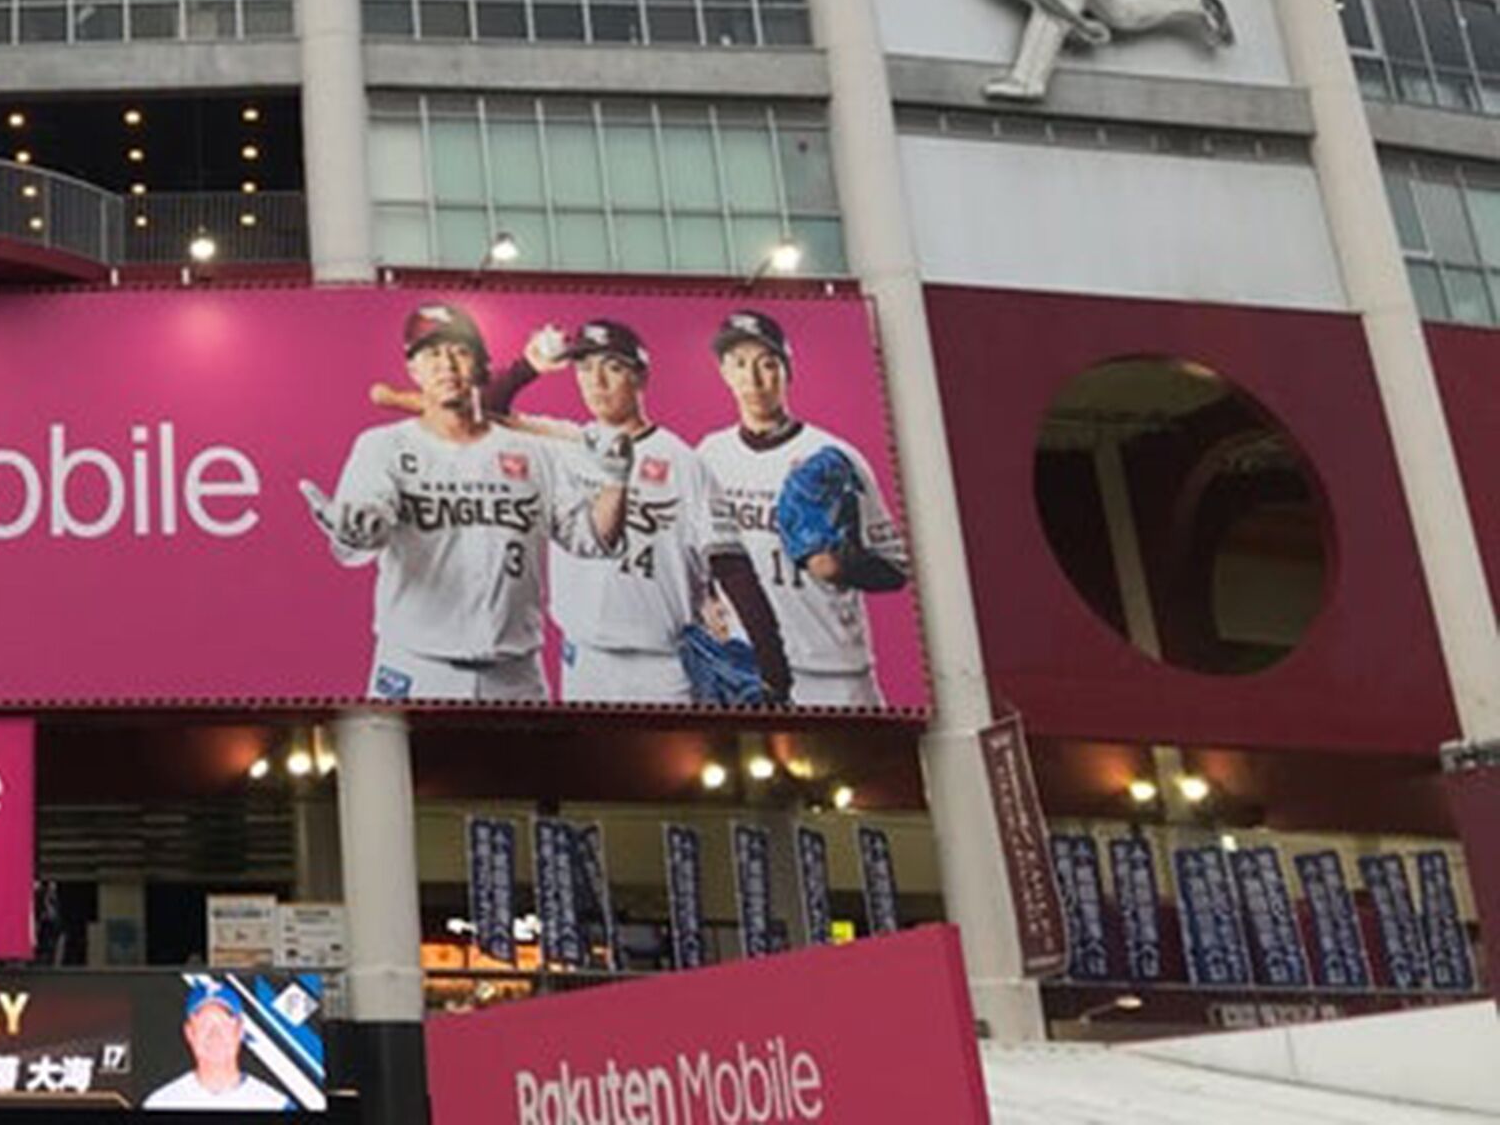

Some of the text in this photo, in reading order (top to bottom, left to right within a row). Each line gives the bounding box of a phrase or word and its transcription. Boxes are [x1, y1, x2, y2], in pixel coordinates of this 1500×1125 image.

[399, 491, 540, 533] EAGLES
[505, 541, 525, 577] 3
[516, 1035, 823, 1125] Rakuten Mobile
